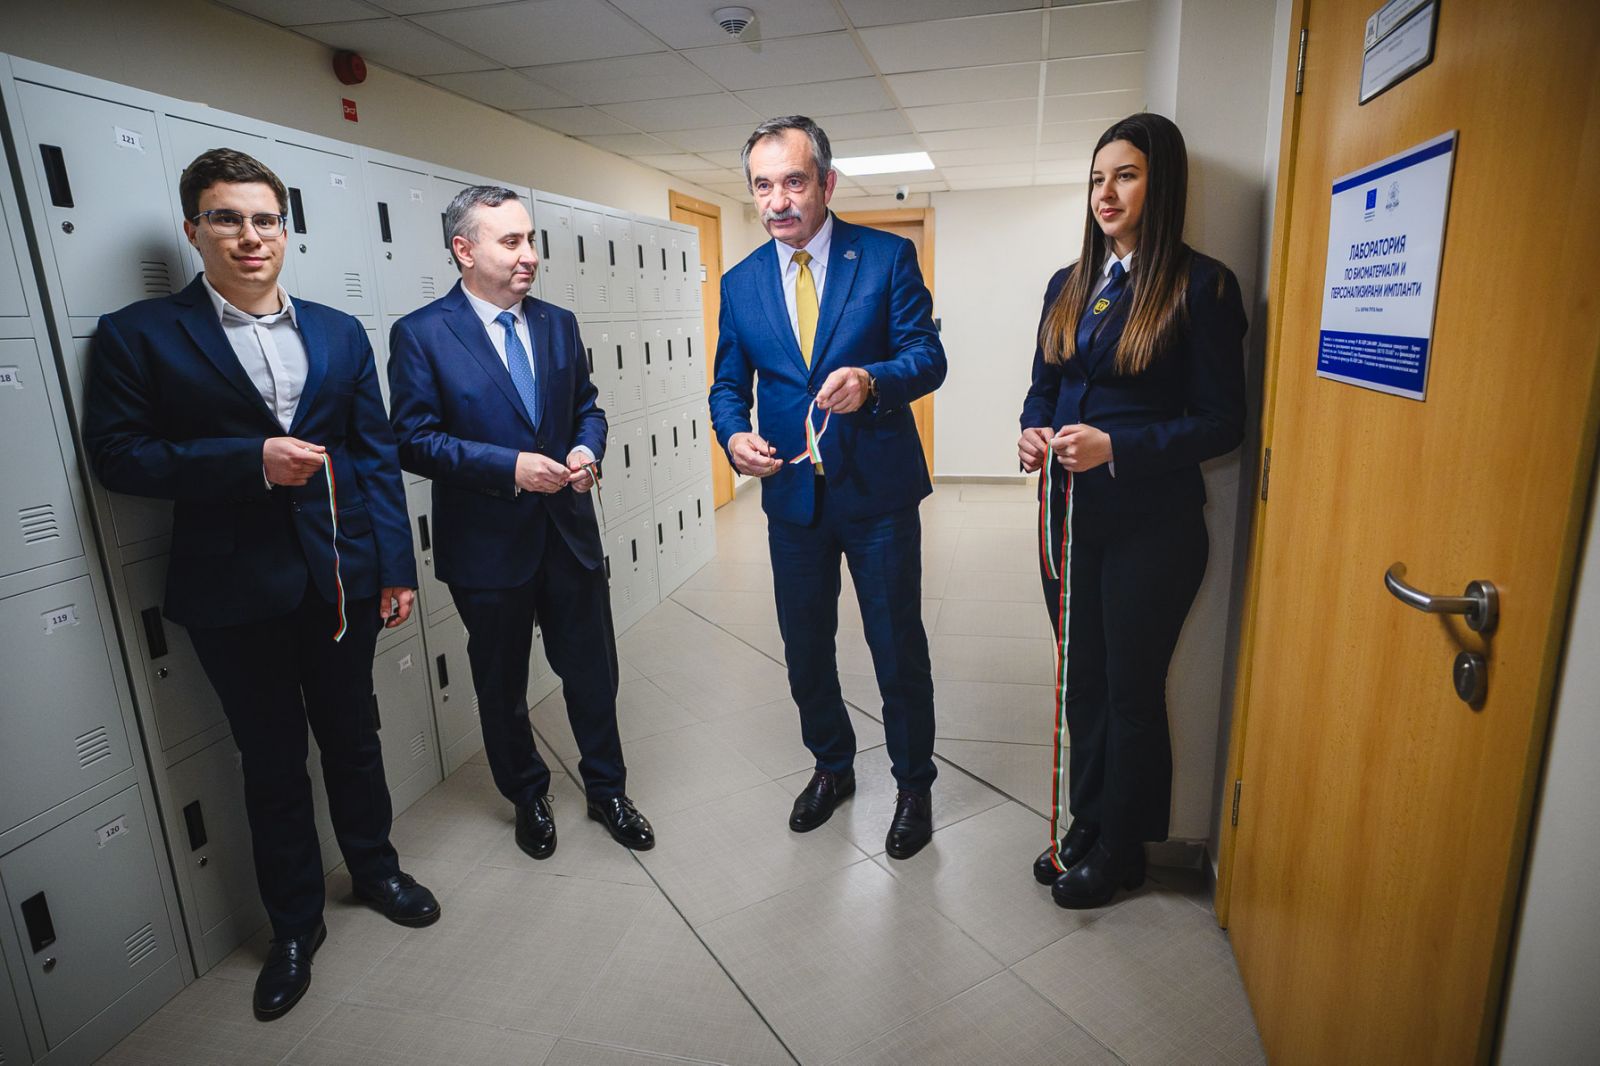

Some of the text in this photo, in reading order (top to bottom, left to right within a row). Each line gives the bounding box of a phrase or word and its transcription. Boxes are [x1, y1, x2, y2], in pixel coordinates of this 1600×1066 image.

[122, 134, 135, 144] 121
[1348, 234, 1407, 261] ЛАБОРАТОРИЯ
[1344, 261, 1407, 281] ПО БИОМАТЕРИАЛИ И
[1331, 281, 1422, 299] ПЕРСОНАЛИЗИРАНИ ИМПЛАНТИ
[52, 614, 68, 624] 119
[105, 825, 120, 837] 120
